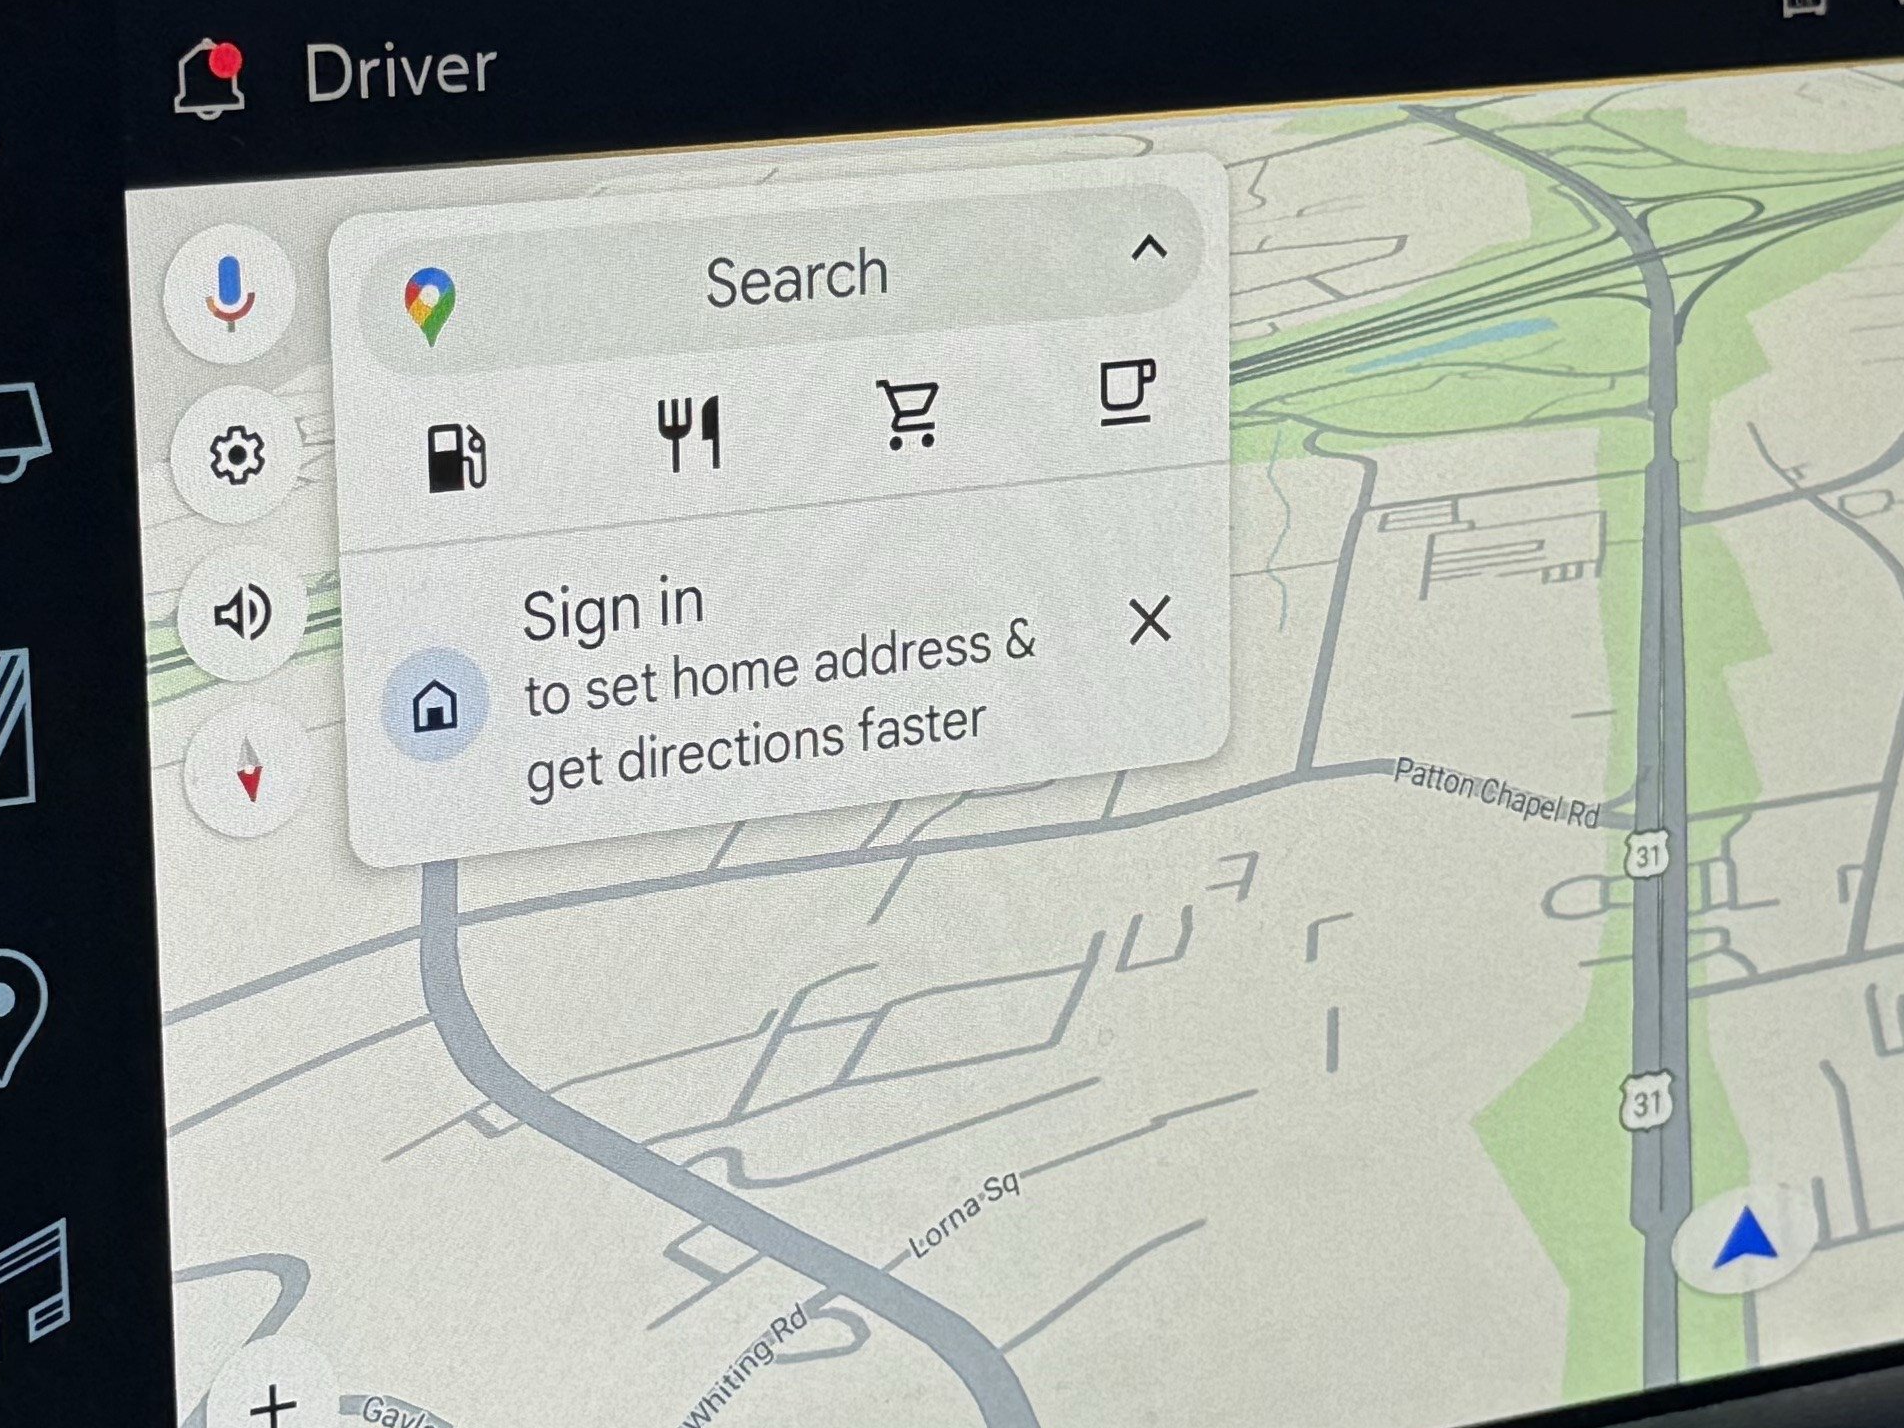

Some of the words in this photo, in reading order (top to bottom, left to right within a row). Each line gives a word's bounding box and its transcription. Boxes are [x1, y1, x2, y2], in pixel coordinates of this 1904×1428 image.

[306, 40, 498, 103] Driver
[705, 246, 888, 309] Search
[523, 584, 641, 650] Sign
[659, 574, 704, 626] in
[525, 675, 570, 717] to
[586, 663, 658, 710] set
[672, 654, 799, 700] home
[814, 629, 992, 682] address
[1005, 616, 1036, 660] &
[526, 746, 604, 806] get
[617, 721, 845, 783] directions
[857, 703, 988, 753] faster
[1394, 756, 1476, 799] Patton
[1480, 777, 1564, 822] Chapel
[1567, 800, 1602, 831] Rd
[1635, 844, 1661, 869] 31
[1632, 1090, 1662, 1119] 31
[908, 1196, 982, 1259] Lorna
[982, 1172, 1021, 1203] Sq
[771, 1302, 809, 1346] Rd
